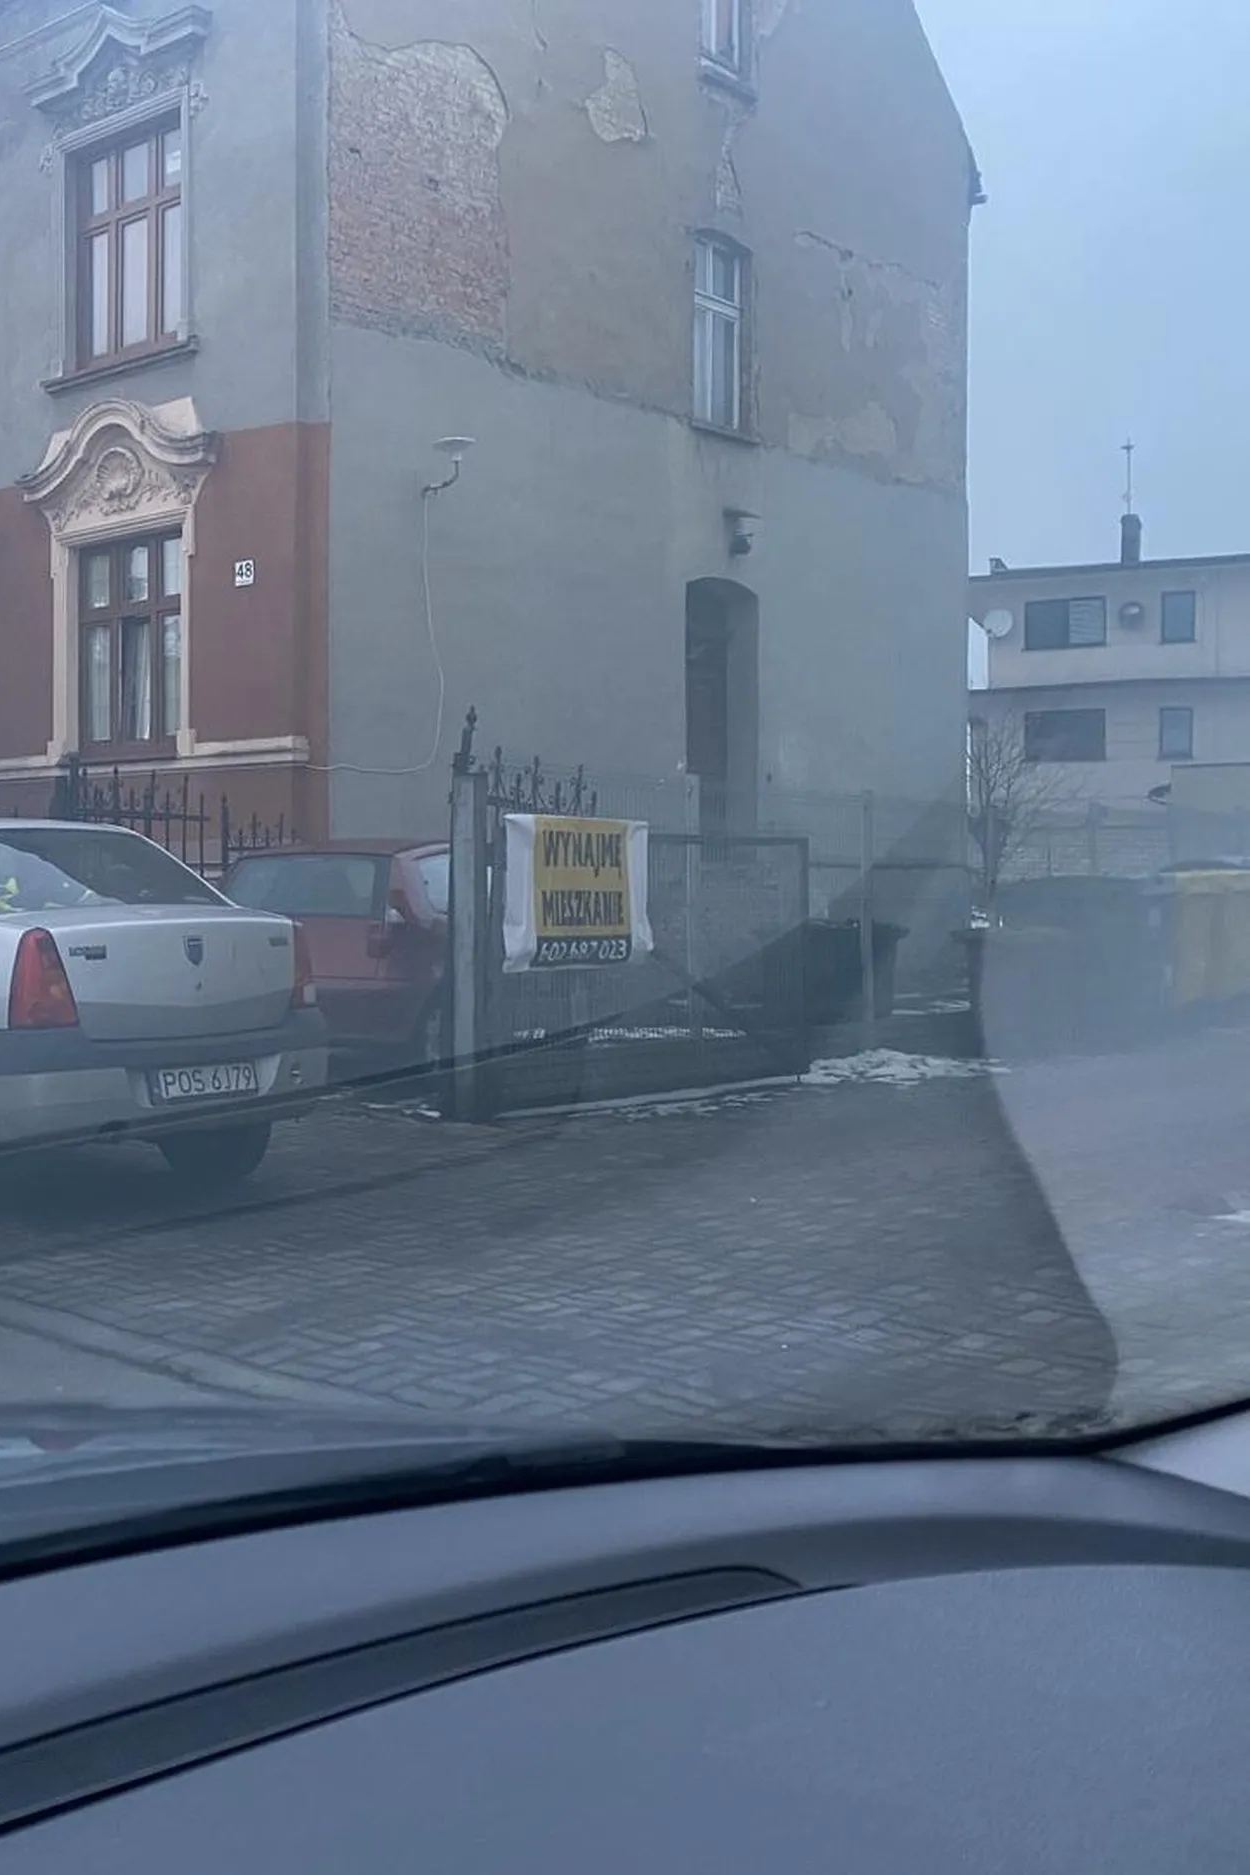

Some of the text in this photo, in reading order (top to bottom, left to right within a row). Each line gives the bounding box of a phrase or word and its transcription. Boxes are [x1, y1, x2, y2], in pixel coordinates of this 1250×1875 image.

[237, 562, 252, 579] 48
[542, 829, 622, 879] WYNAJMĘ
[541, 890, 625, 926] MIESZKANIE
[599, 939, 627, 959] 023
[162, 1068, 206, 1097] POS
